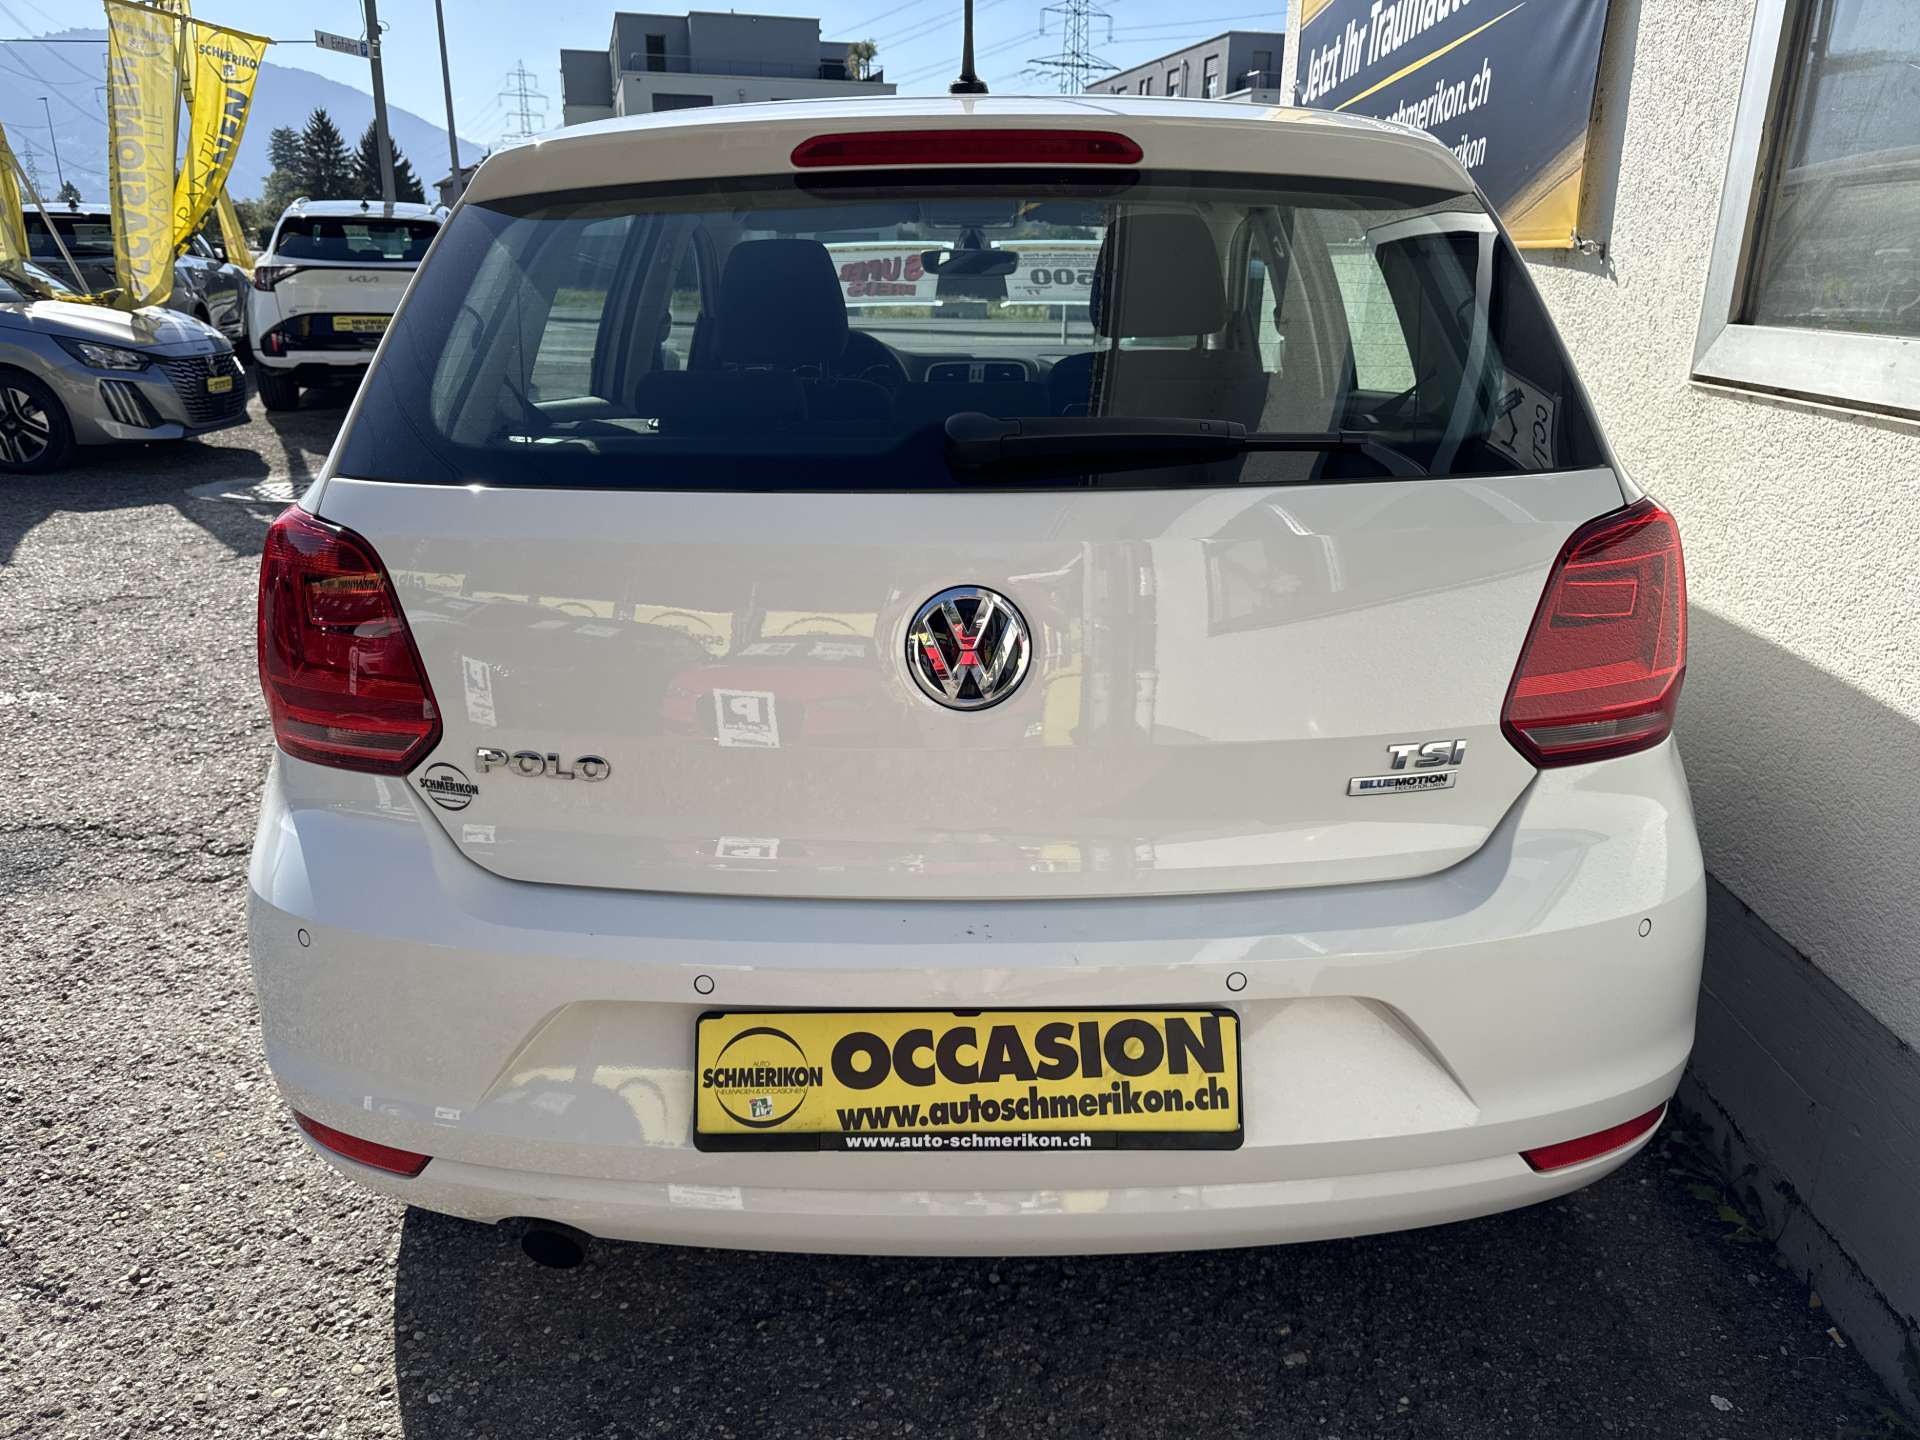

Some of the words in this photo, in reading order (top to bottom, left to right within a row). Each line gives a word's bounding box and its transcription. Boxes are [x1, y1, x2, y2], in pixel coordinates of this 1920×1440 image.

[198, 43, 259, 70] SCHMERIKO
[1301, 34, 1341, 105] Jetzt
[1340, 18, 1368, 83] Ihr
[1450, 133, 1487, 169] rikon
[475, 746, 611, 782] POLO
[1387, 738, 1468, 770] TSI
[419, 777, 479, 795] SCHMERIKON
[1360, 773, 1448, 790] BLUEMOTION
[831, 1016, 1225, 1091] OCCASION
[702, 1066, 823, 1089] SCHMERIKON
[718, 1087, 755, 1096] NEUWAGEN
[836, 1076, 1230, 1131] www.autoschmerikon.ch
[845, 1132, 1092, 1148] www.auto-schmerikon.ch
